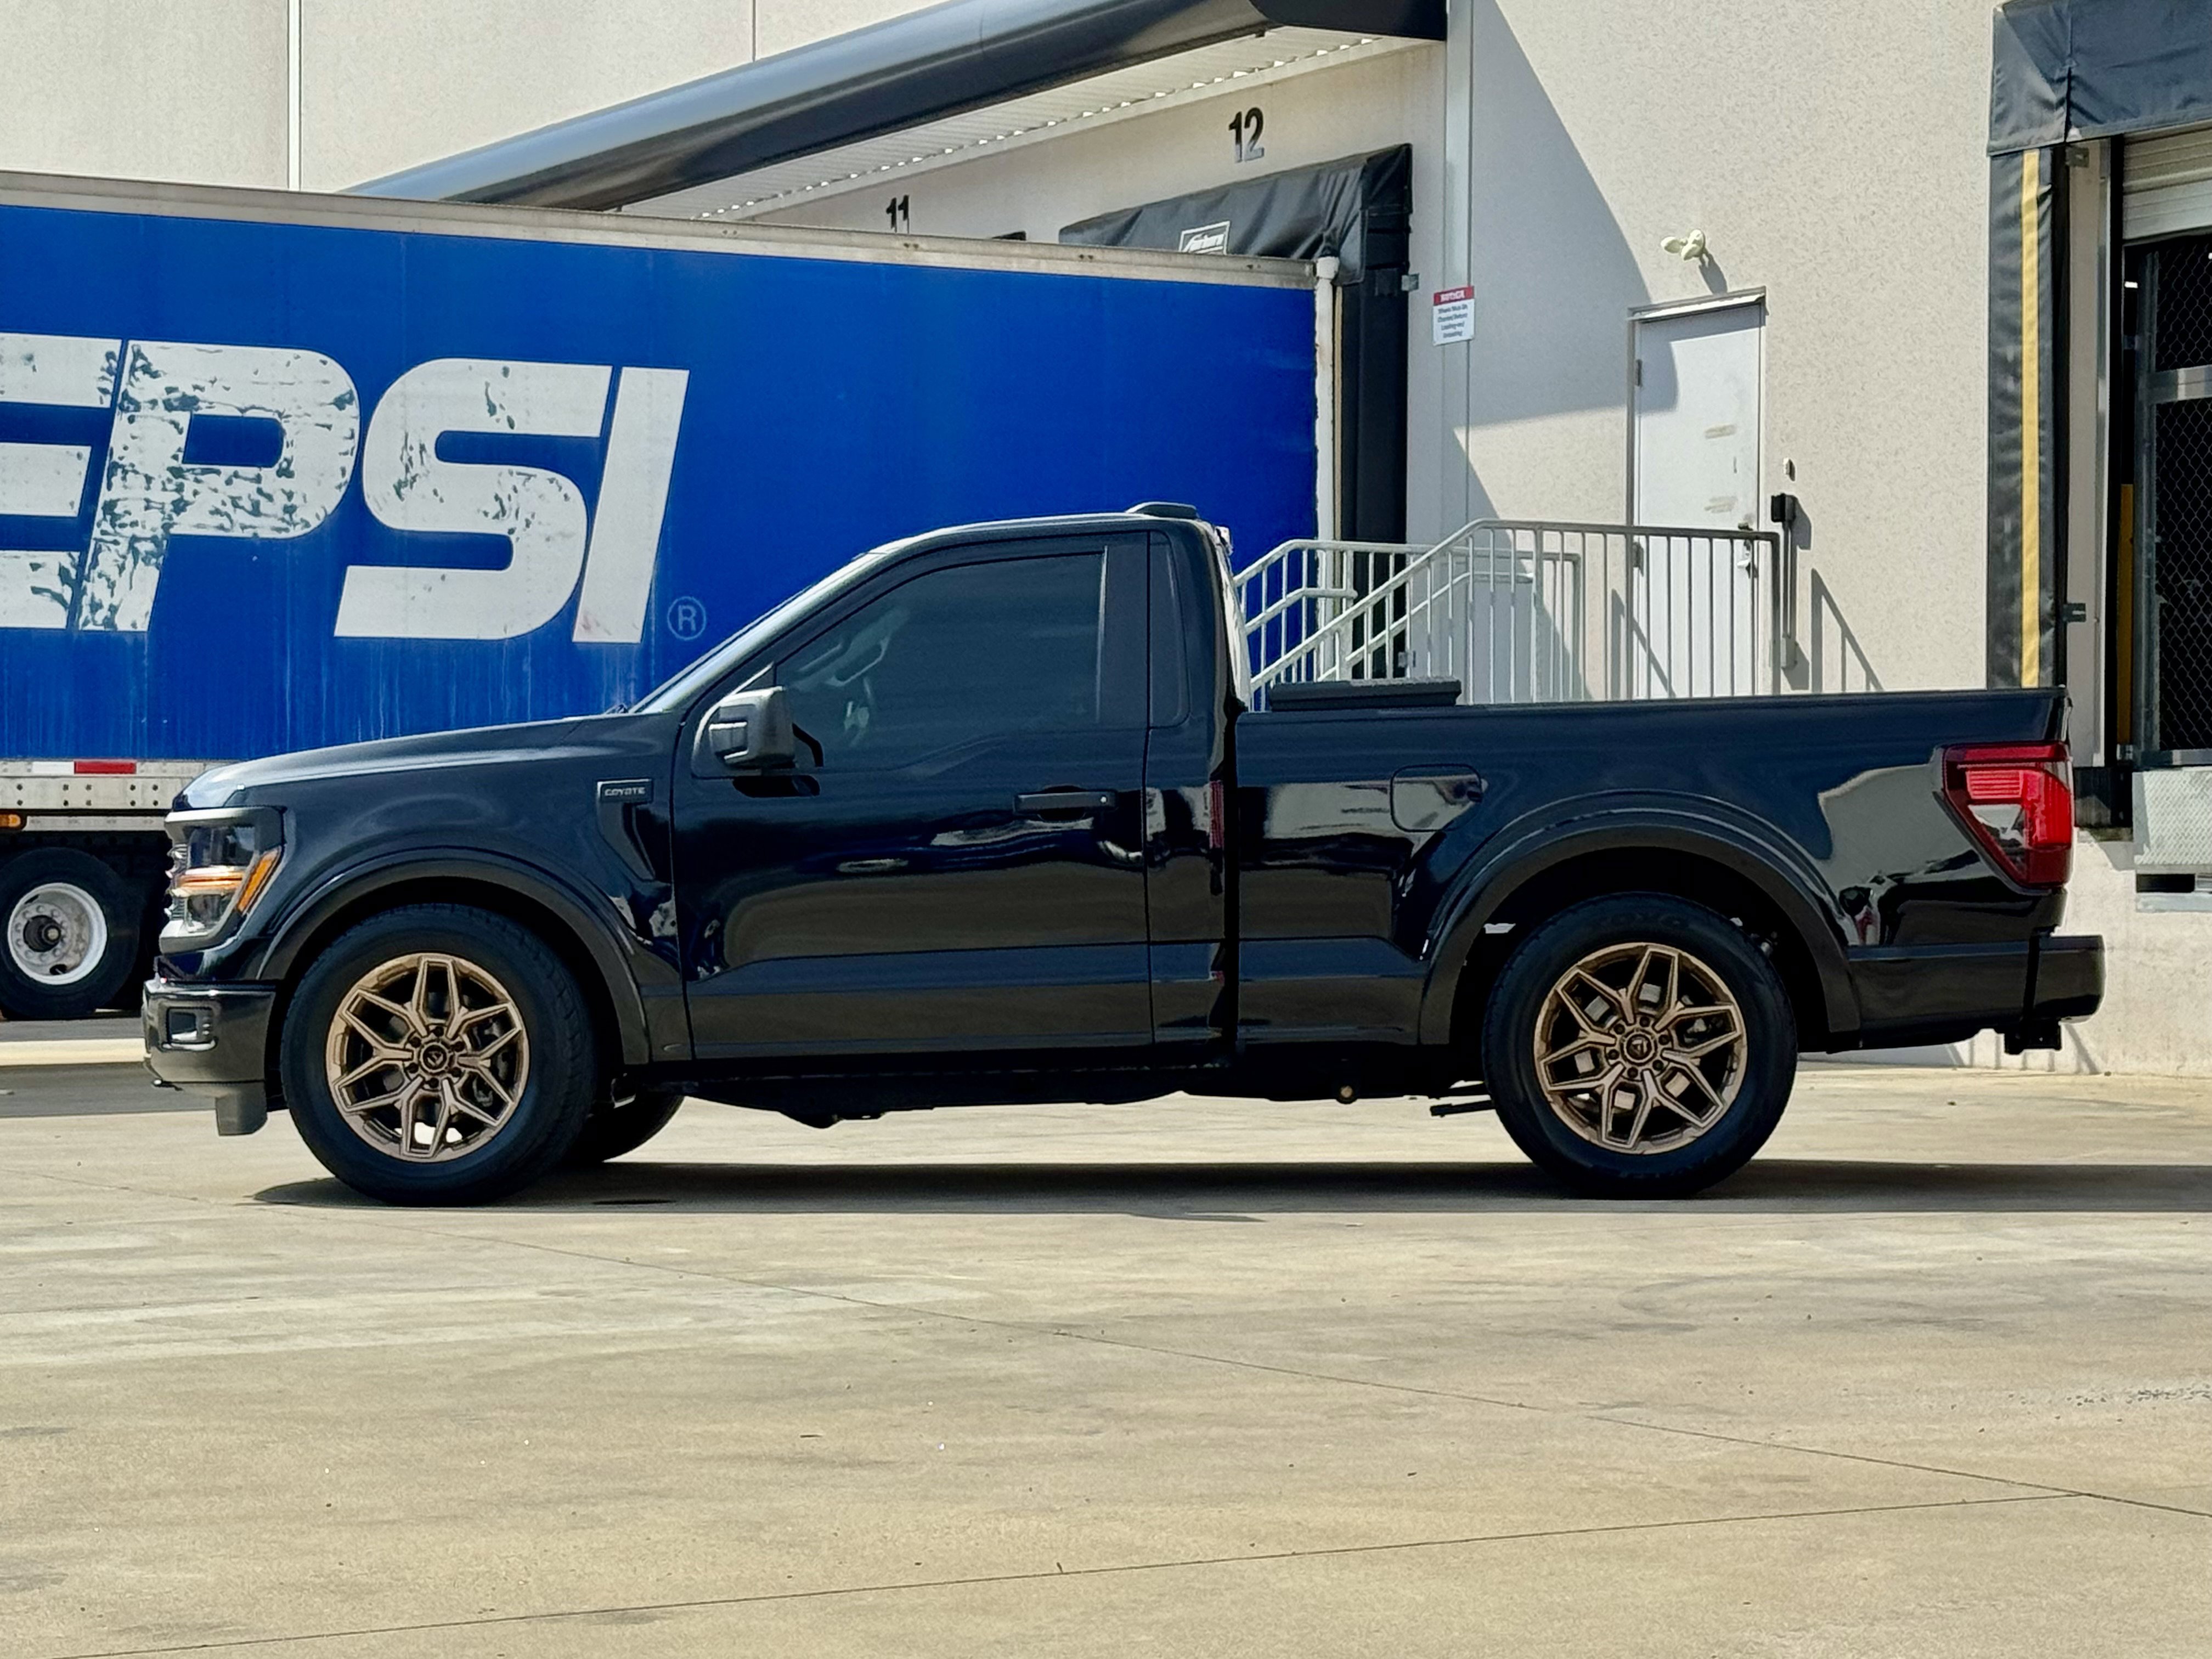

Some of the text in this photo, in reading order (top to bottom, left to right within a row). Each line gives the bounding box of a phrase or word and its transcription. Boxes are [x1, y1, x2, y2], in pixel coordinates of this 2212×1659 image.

[1228, 107, 1265, 163] 12
[886, 194, 910, 234] 11
[605, 787, 646, 796] COYOTE
